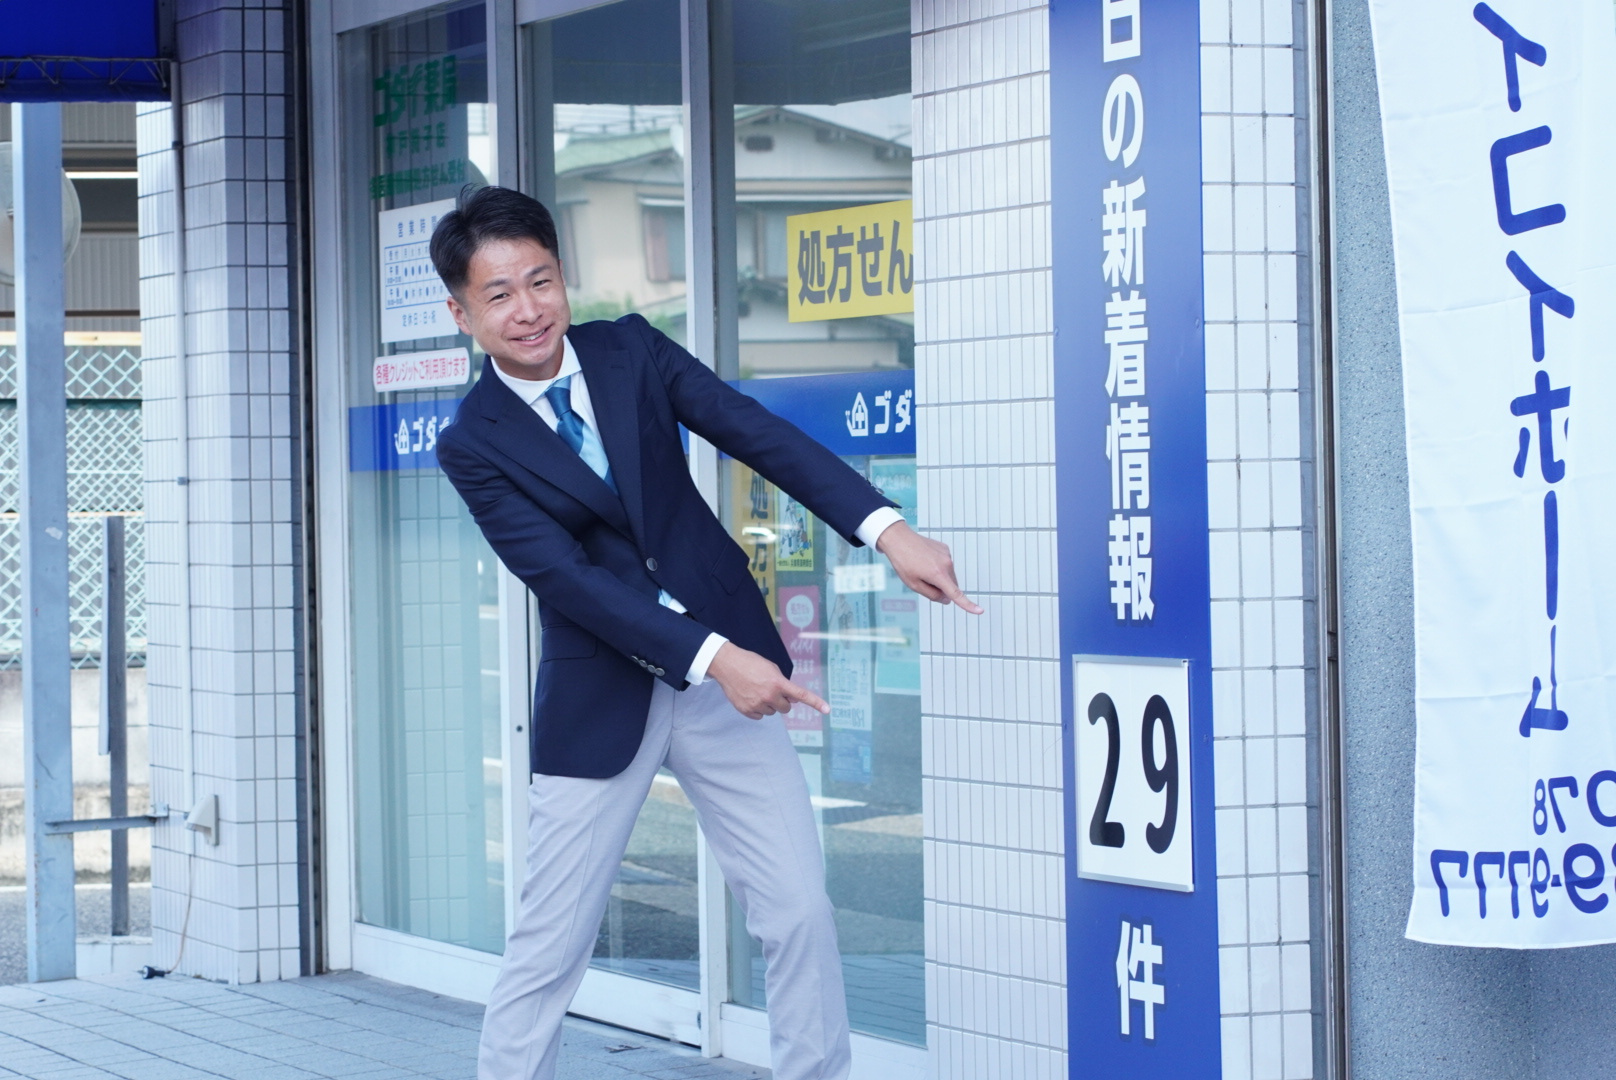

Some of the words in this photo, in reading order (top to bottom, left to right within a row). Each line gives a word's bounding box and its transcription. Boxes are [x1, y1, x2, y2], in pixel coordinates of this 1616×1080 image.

[798, 220, 914, 306] 処方せん
[1087, 692, 1179, 854] 29
[1115, 920, 1165, 1040] 件
